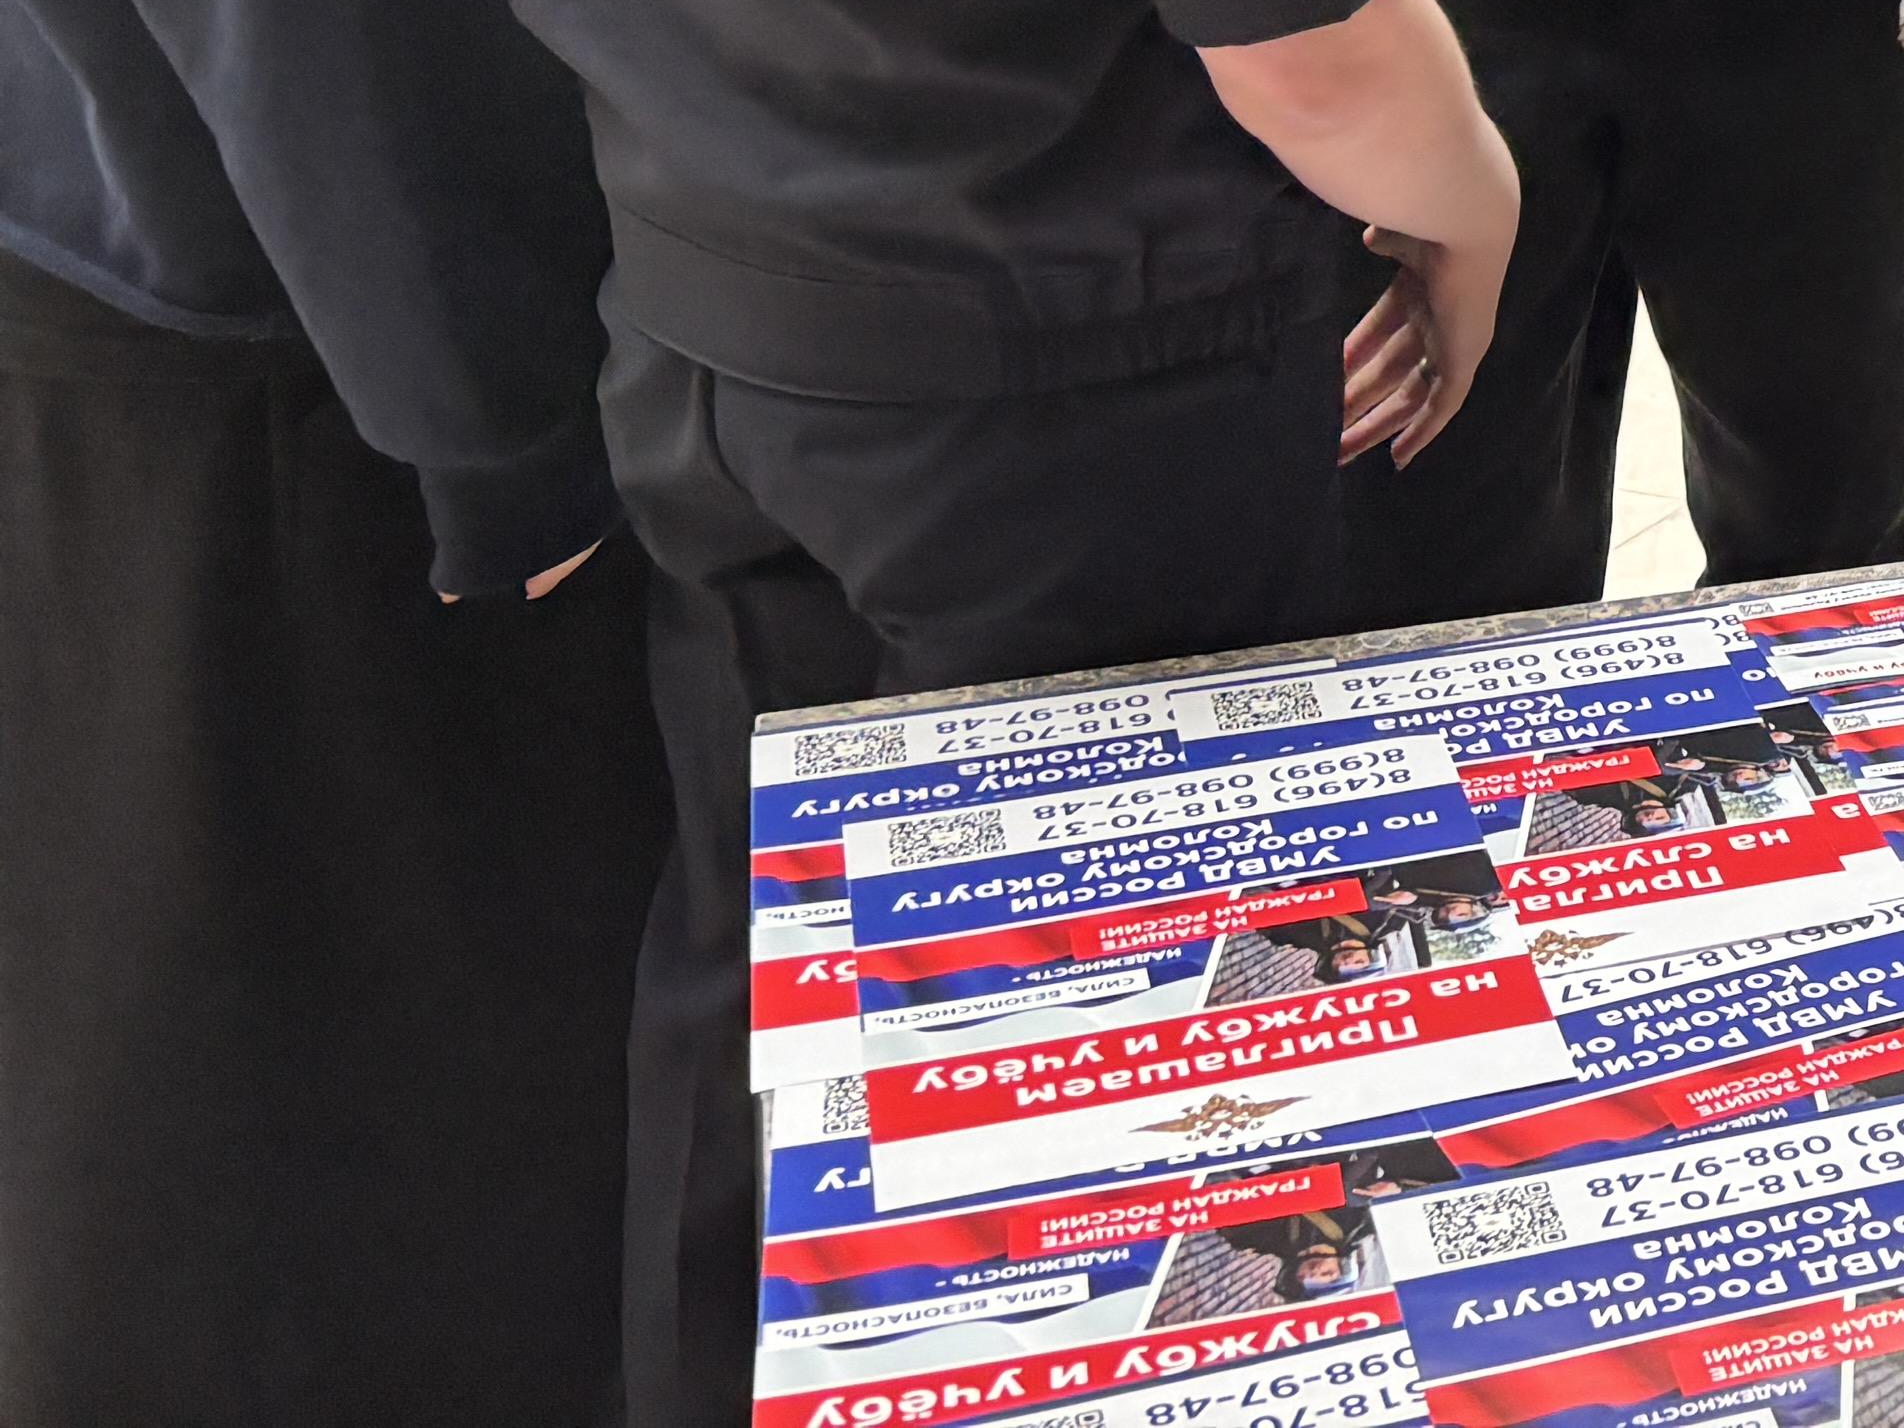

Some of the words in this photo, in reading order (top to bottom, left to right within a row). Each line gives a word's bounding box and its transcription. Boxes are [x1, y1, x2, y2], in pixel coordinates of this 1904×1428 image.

[1554, 634, 1677, 664] 8(999)
[1561, 650, 1685, 681] 8(496)
[1341, 655, 1540, 692] 098-97-48
[1350, 670, 1546, 710] 618-70-37
[935, 694, 1149, 736] 098-97-48
[1373, 692, 1563, 733] Коломна
[1665, 687, 1716, 707] по
[938, 711, 1151, 754] 618-70-37
[1499, 717, 1630, 753] УМВД
[958, 736, 1163, 777] Коломна
[978, 748, 1183, 793] одскому
[1270, 748, 1405, 783] 8(999)
[1520, 754, 1630, 782] ГРАЖДАН
[792, 783, 960, 819] округу
[1032, 773, 1256, 823] 098-97-48
[1273, 768, 1411, 814] 8(496)
[1462, 781, 1517, 798] ЗАЩ
[1520, 776, 1552, 789] НА
[1038, 793, 1259, 842] 618-70-37
[1383, 810, 1438, 831] по
[1060, 817, 1273, 866] Коломна
[1083, 818, 1369, 882] городскому
[1728, 828, 1790, 853] на
[1199, 844, 1342, 887] УМВД
[1508, 843, 1712, 890] службу
[892, 871, 1065, 913] округу
[1010, 872, 1185, 913] России
[1212, 888, 1337, 924] ГРАЖДАН
[1510, 865, 1725, 918] Пригла
[1100, 909, 1208, 938] РОССИИ!
[1100, 924, 1208, 952] ЗАЩИТЕ
[1212, 914, 1249, 928] НА
[1027, 949, 1181, 983] НАДЕЖНОСТЬ
[1067, 975, 1135, 995] СИЛА,
[1429, 971, 1498, 1000] на
[1561, 936, 1773, 1003] 618-70-37
[873, 989, 1061, 1026] БЕЗОПАСНОСТЬ,
[1596, 963, 1810, 1026] Коломна
[1754, 989, 1897, 1037] УМВД
[1181, 989, 1412, 1046] службу
[1014, 1015, 1419, 1107] Приглашаем
[1124, 1029, 1157, 1054] и
[1574, 1026, 1743, 1083] России
[913, 1039, 1100, 1093] учёбу
[1685, 1065, 1791, 1104] РОССИИ!
[1802, 1069, 1840, 1086] НА
[1695, 1082, 1799, 1116] ЗАЩИТЕ
[1586, 1136, 1832, 1198] 098-97-48
[1172, 1176, 1311, 1212] ГРАЖДАН
[1600, 1163, 1844, 1228] 618-70-37
[1040, 1200, 1165, 1233] РОССИИ!
[1040, 1218, 1161, 1248] ЗАЩИТЕ
[1167, 1210, 1208, 1228] НА
[1632, 1196, 1873, 1261] Коломна
[951, 1248, 1130, 1288] НАДЕЖНОСТЬ
[996, 1283, 1073, 1306] СИЛА,
[1452, 1272, 1646, 1329] округу
[1588, 1270, 1789, 1329] России
[775, 1297, 988, 1341] БЕЗОПАСНОСТЬ,
[1113, 1312, 1381, 1379] службу
[1703, 1327, 1824, 1364] РОССИИ!
[1708, 1345, 1829, 1382] ЗАЩИТЕ
[1833, 1334, 1874, 1355] НА
[1049, 1361, 1088, 1391] и
[806, 1367, 1025, 1427] учёбу
[1631, 1379, 1807, 1426] НАДЕЖНОСТЬ
